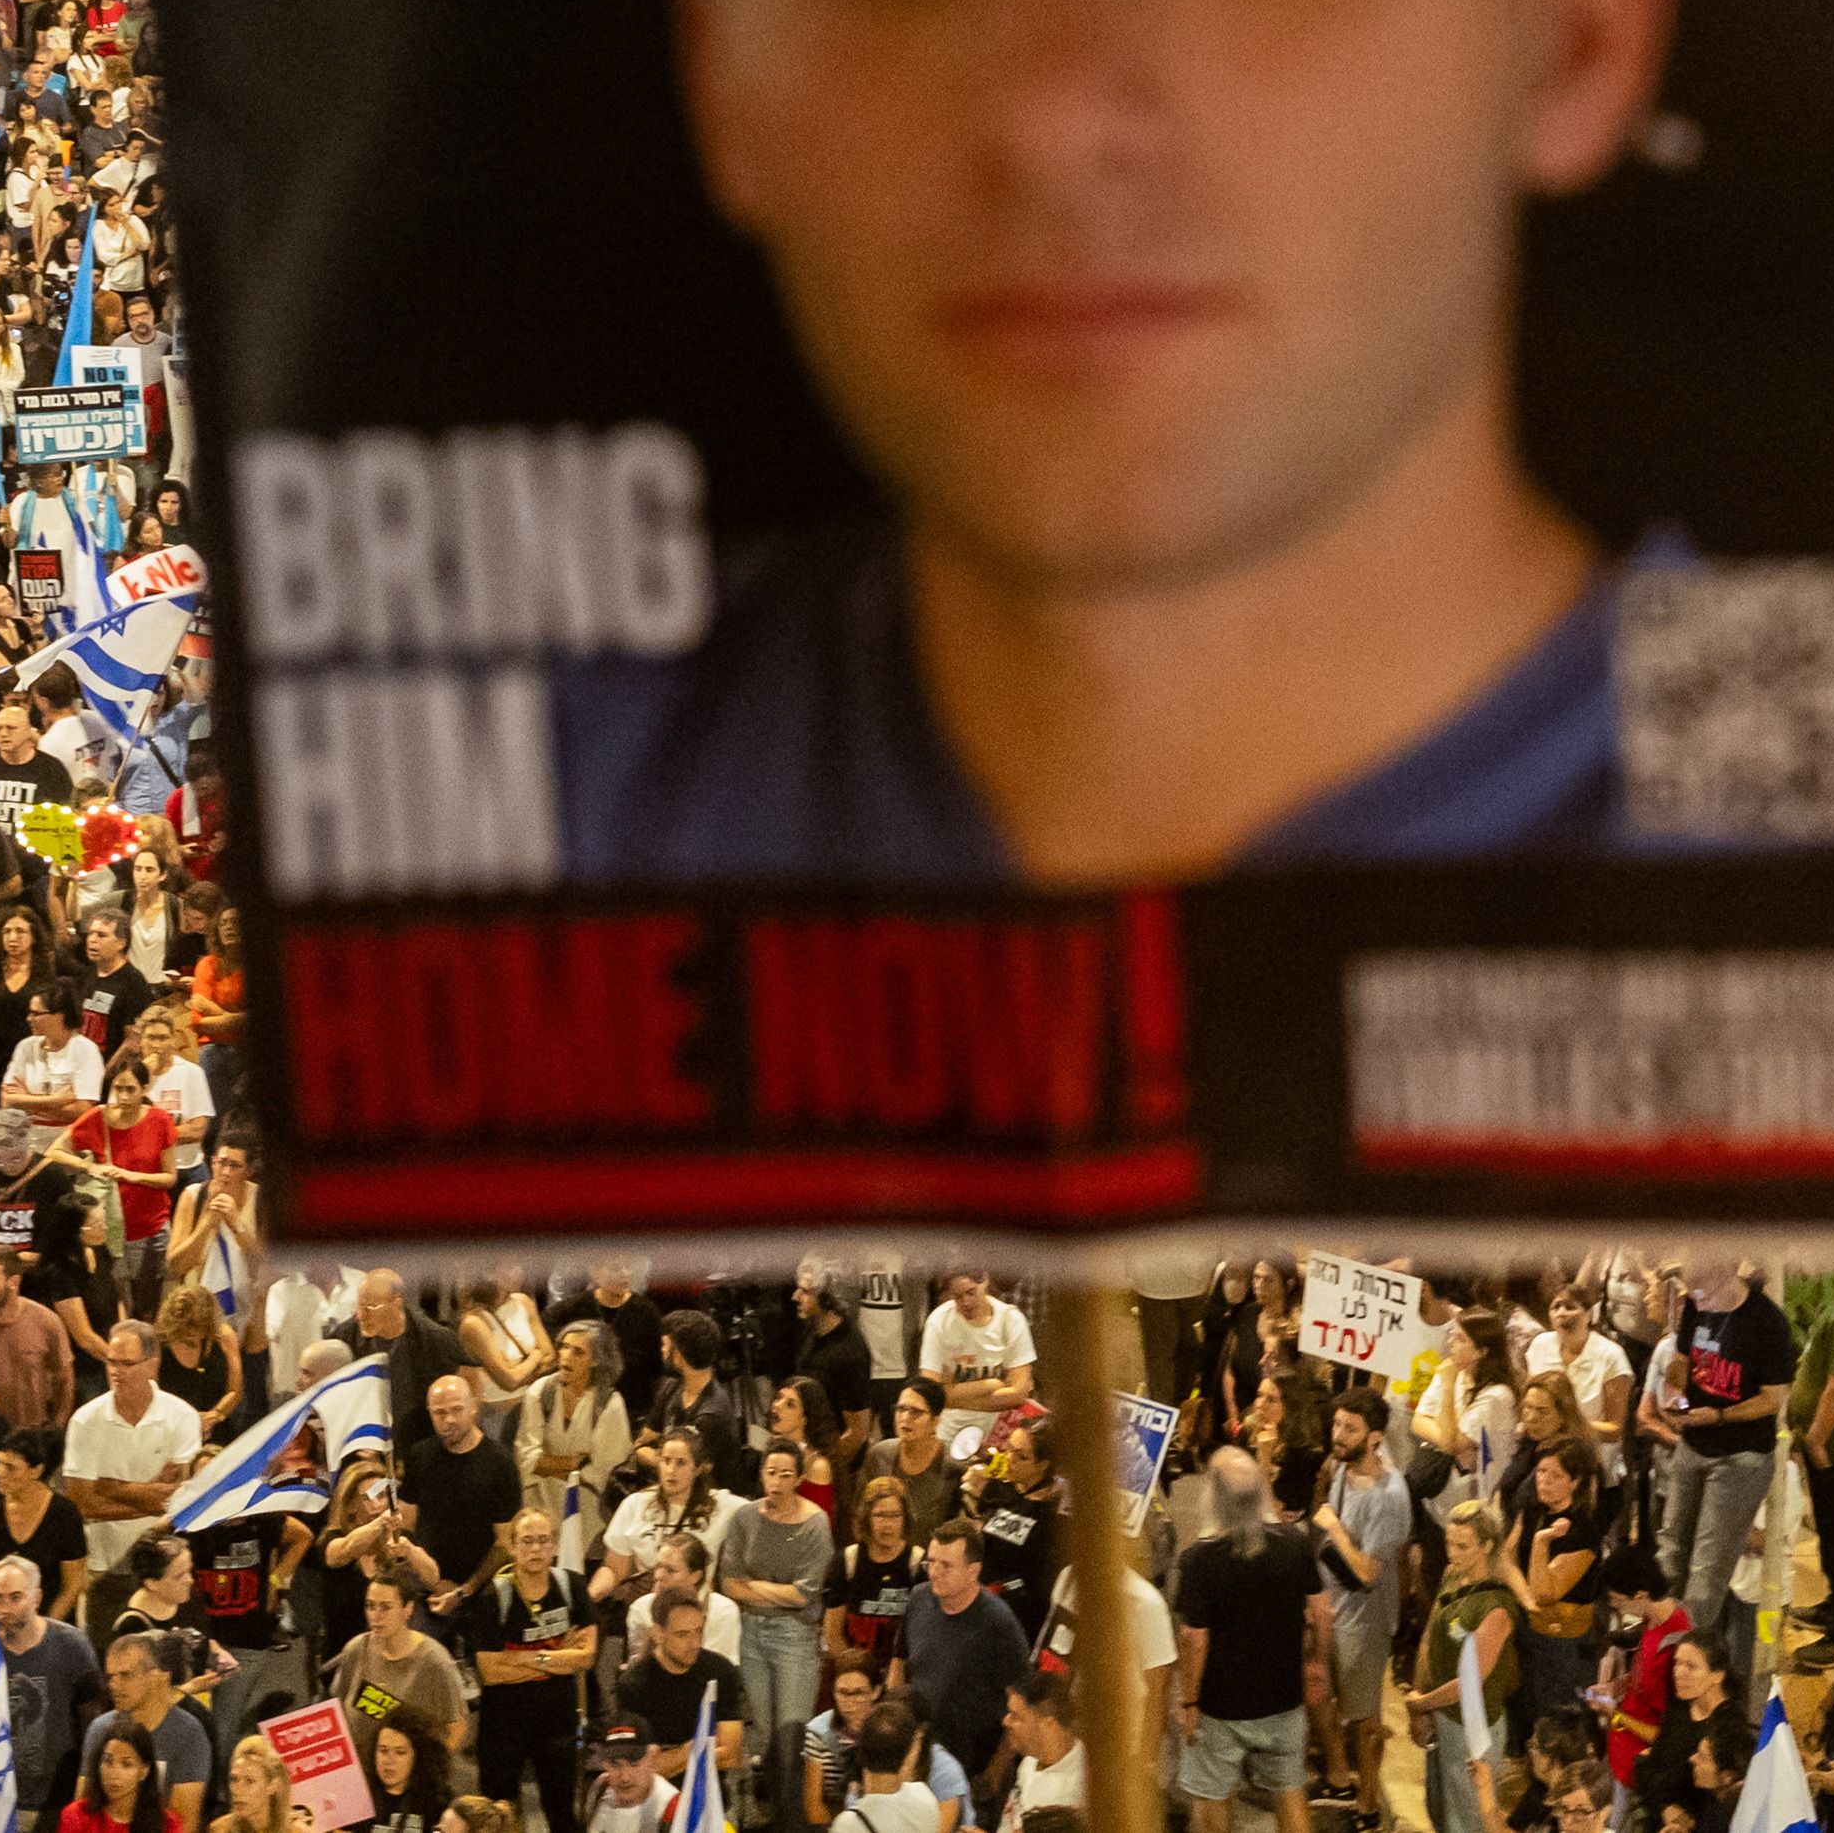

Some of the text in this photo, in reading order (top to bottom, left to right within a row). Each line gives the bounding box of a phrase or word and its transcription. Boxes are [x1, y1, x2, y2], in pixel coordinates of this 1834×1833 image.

[21, 424, 125, 453] עכשיו!
[70, 393, 101, 405] מחיר
[102, 391, 121, 406] אין
[236, 426, 712, 659] BRING
[257, 672, 557, 894] HIM
[286, 886, 1185, 1138] HOME NOW!
